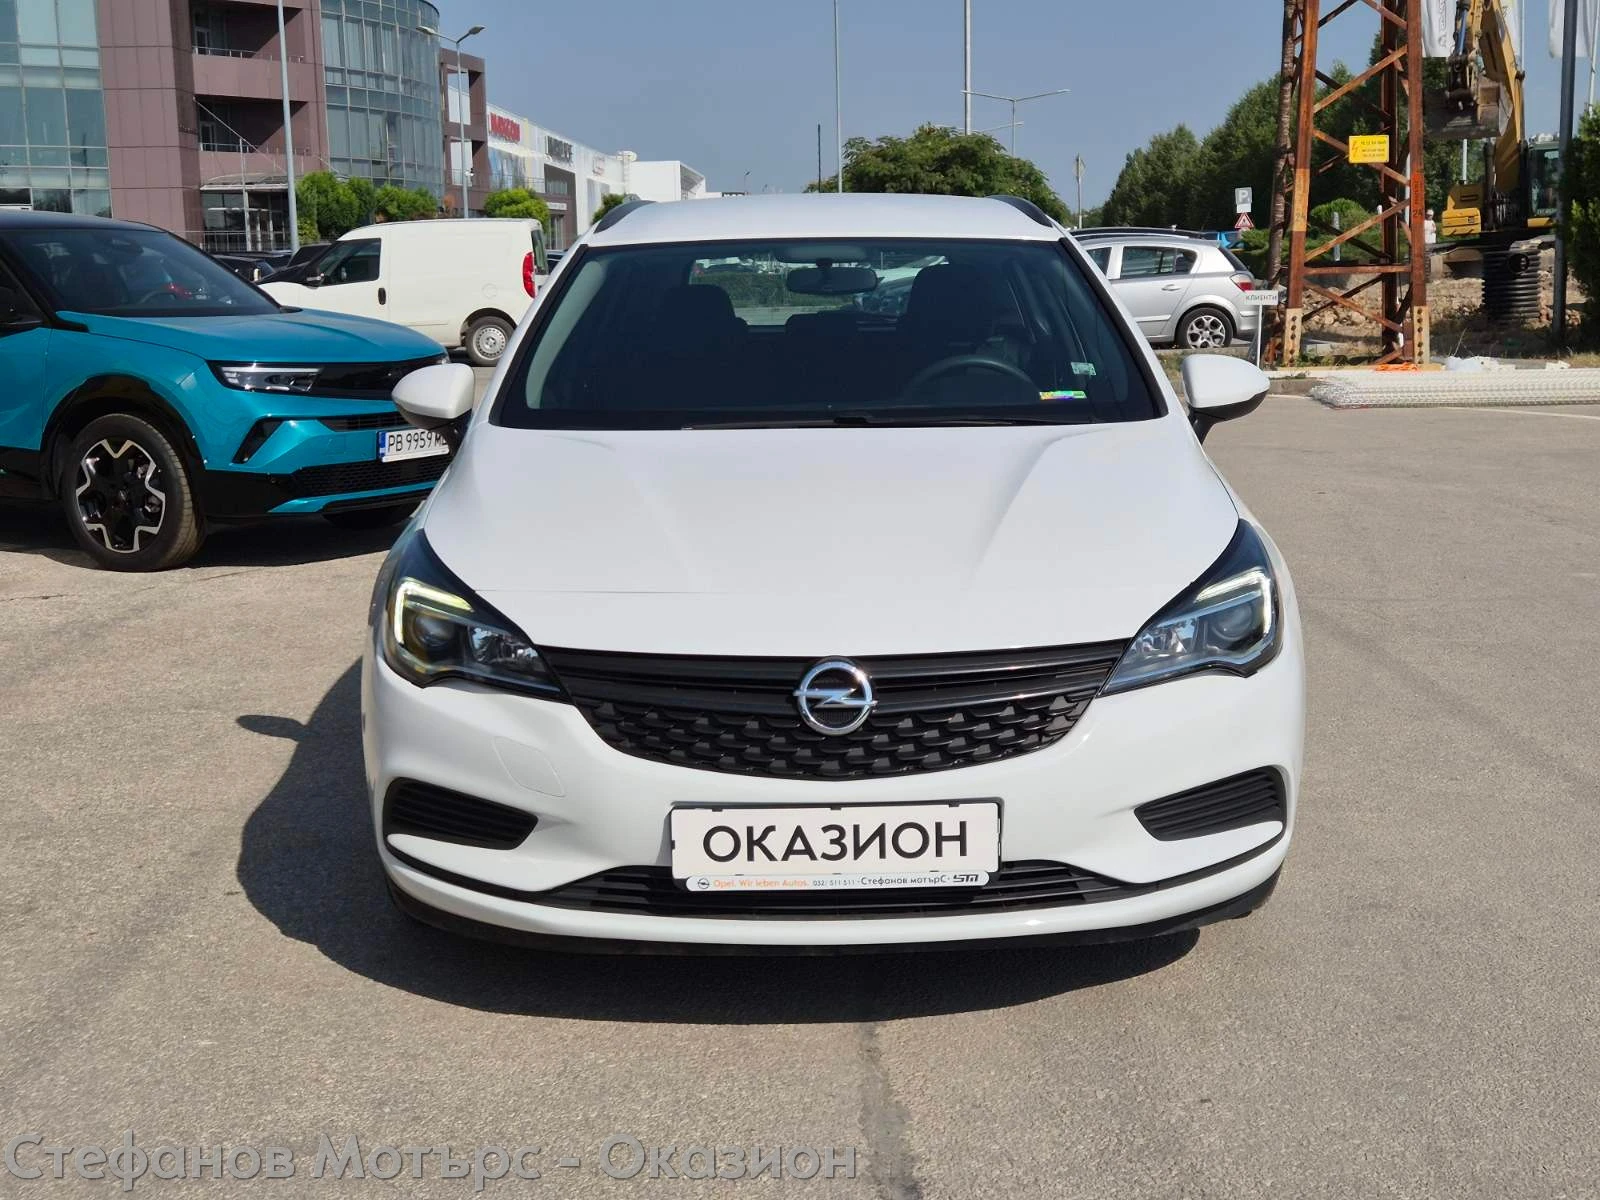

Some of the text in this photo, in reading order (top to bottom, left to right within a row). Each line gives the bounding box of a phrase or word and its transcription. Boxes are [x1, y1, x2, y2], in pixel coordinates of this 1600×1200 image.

[1239, 190, 1249, 202] P
[388, 433, 403, 453] PB
[406, 431, 433, 450] 9959
[703, 821, 967, 862] ОКАЗИОН
